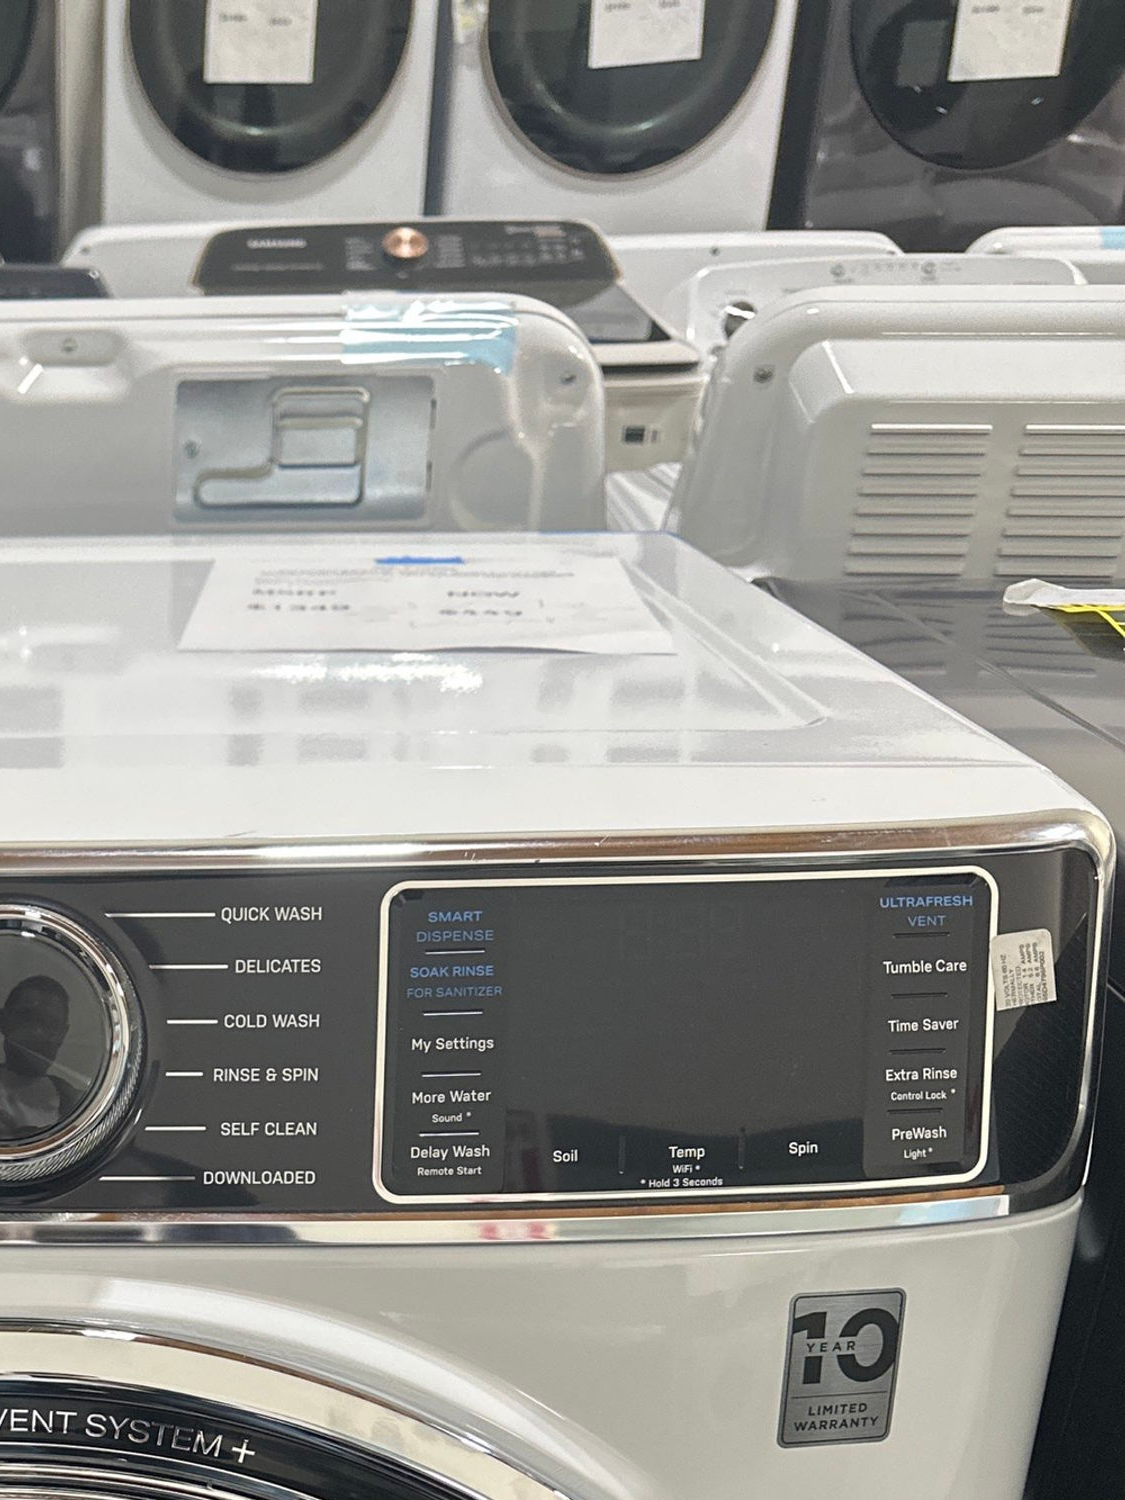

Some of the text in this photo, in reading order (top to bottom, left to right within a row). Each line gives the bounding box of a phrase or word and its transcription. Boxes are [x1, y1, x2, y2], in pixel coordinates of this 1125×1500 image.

[879, 896, 973, 908] ULTRAFRESH
[221, 906, 323, 922] QUICK WASH
[428, 911, 483, 922] SMART
[907, 915, 946, 927] VENT
[416, 930, 494, 942] DISPENSE
[234, 959, 321, 974] DELICATES
[410, 965, 494, 978] SOAK RINSE
[883, 959, 967, 974] Tumble Care
[406, 986, 502, 998] FOR SANITIZER
[223, 1014, 320, 1028] COLD WASH
[888, 1018, 959, 1032] Time Saver
[411, 1037, 494, 1053] My Settings
[212, 1068, 319, 1082] RINSE & SPIN
[885, 1067, 958, 1081] Extra Rinse
[411, 1090, 491, 1104] More Water
[890, 1090, 947, 1101] Control Lock
[432, 1113, 463, 1123] Sound
[220, 1122, 317, 1136] SELF CLEAN
[892, 1126, 947, 1141] PreWash
[411, 1145, 490, 1160] Delay Wash
[669, 1145, 705, 1160] Temp
[789, 1141, 819, 1156] Spin
[904, 1149, 927, 1160] Light
[552, 1149, 579, 1163] Soil
[417, 1166, 482, 1176] Remote Start
[672, 1164, 693, 1174] WiFi
[203, 1171, 316, 1185] DOWNLOADED
[648, 1176, 723, 1188] Hold 3 Seconds
[792, 1307, 899, 1385] 10
[806, 1340, 856, 1353] YEAR
[808, 1402, 868, 1416] LIMITED
[794, 1416, 879, 1431] WARRANTY
[85, 1412, 223, 1458] SYSTEM
